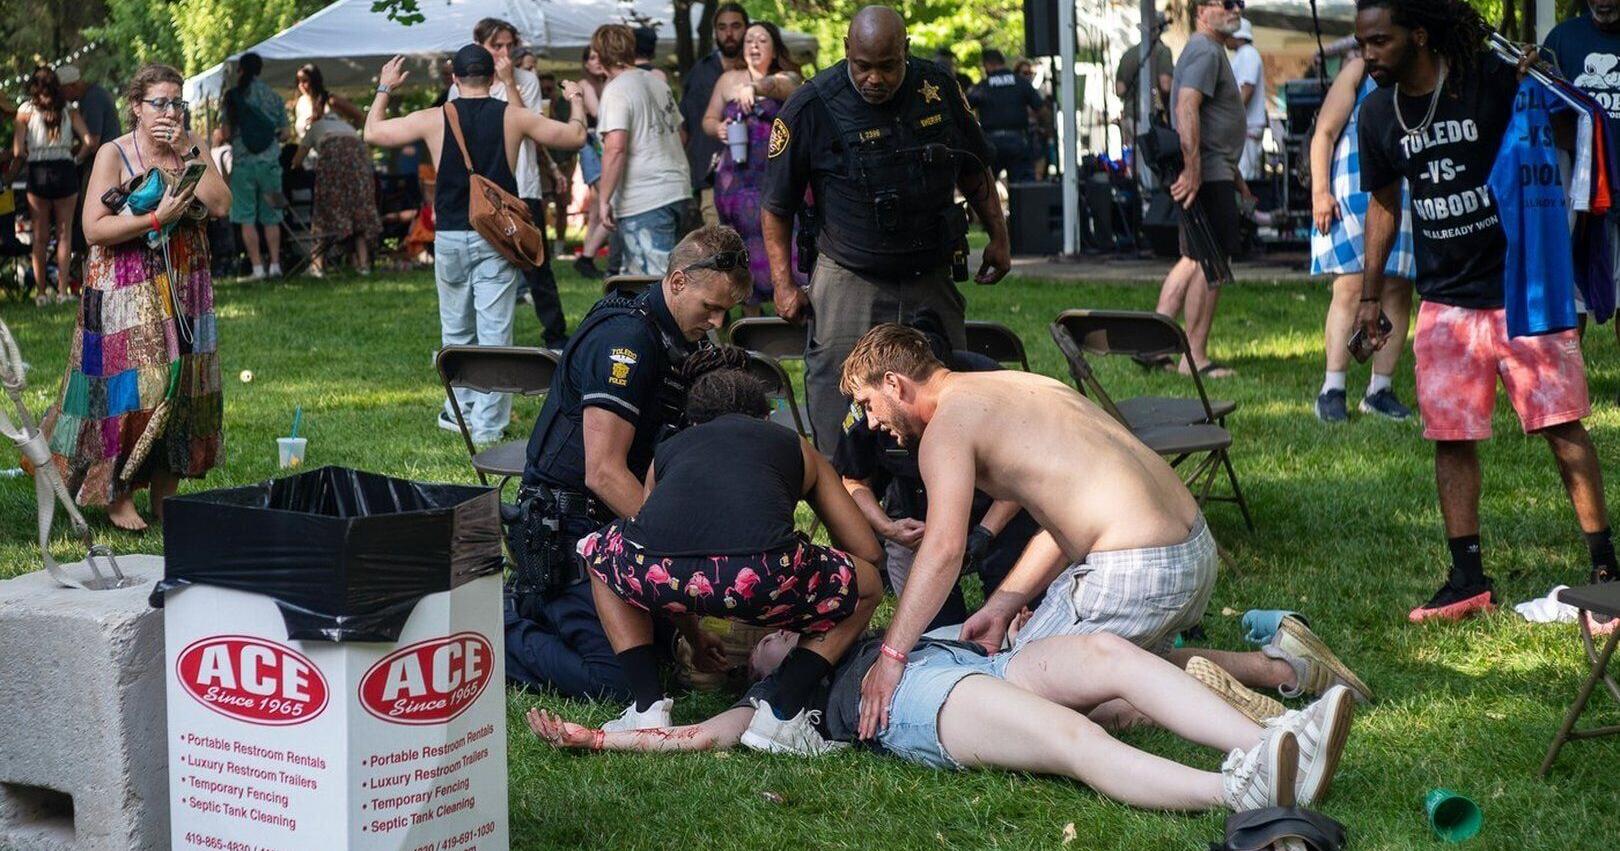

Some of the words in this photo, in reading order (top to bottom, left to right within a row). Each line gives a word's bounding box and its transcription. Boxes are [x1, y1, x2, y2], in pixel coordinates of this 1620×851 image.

[1400, 119, 1479, 160] TOLEDO
[1420, 158, 1466, 184] -VS-
[1413, 184, 1491, 221] NOBODY
[1475, 215, 1499, 230] WON
[611, 348, 637, 360] TOLEDO
[608, 376, 628, 387] POLICE
[196, 644, 311, 702] ACE
[381, 640, 483, 701] ACE
[203, 686, 255, 708] Since
[259, 697, 303, 716] 1965
[389, 698, 447, 716] Since
[450, 681, 478, 706] 1965
[187, 733, 231, 751] Portable
[233, 741, 284, 761] Restroom
[287, 751, 326, 769] Rentals
[370, 749, 419, 768] Portable
[422, 738, 466, 758] Restroom
[467, 724, 494, 744] Rentals
[188, 754, 224, 773] Luxury
[227, 762, 277, 781] Restroom
[279, 771, 317, 790] Trailers
[370, 773, 411, 790] Luxury
[415, 760, 462, 781] Restroom
[462, 748, 489, 767] Trailers
[189, 776, 244, 799] Temporary
[247, 787, 289, 808] Fencing
[371, 790, 433, 811] Temporary
[435, 778, 470, 798] Fencing
[189, 796, 222, 813] Septic
[223, 803, 247, 819] Tank
[250, 809, 296, 831] Cleaning
[371, 816, 408, 833] Septic
[410, 809, 434, 825] Tank
[436, 797, 475, 818] Cleaning
[442, 821, 496, 851] 419-691-1030
